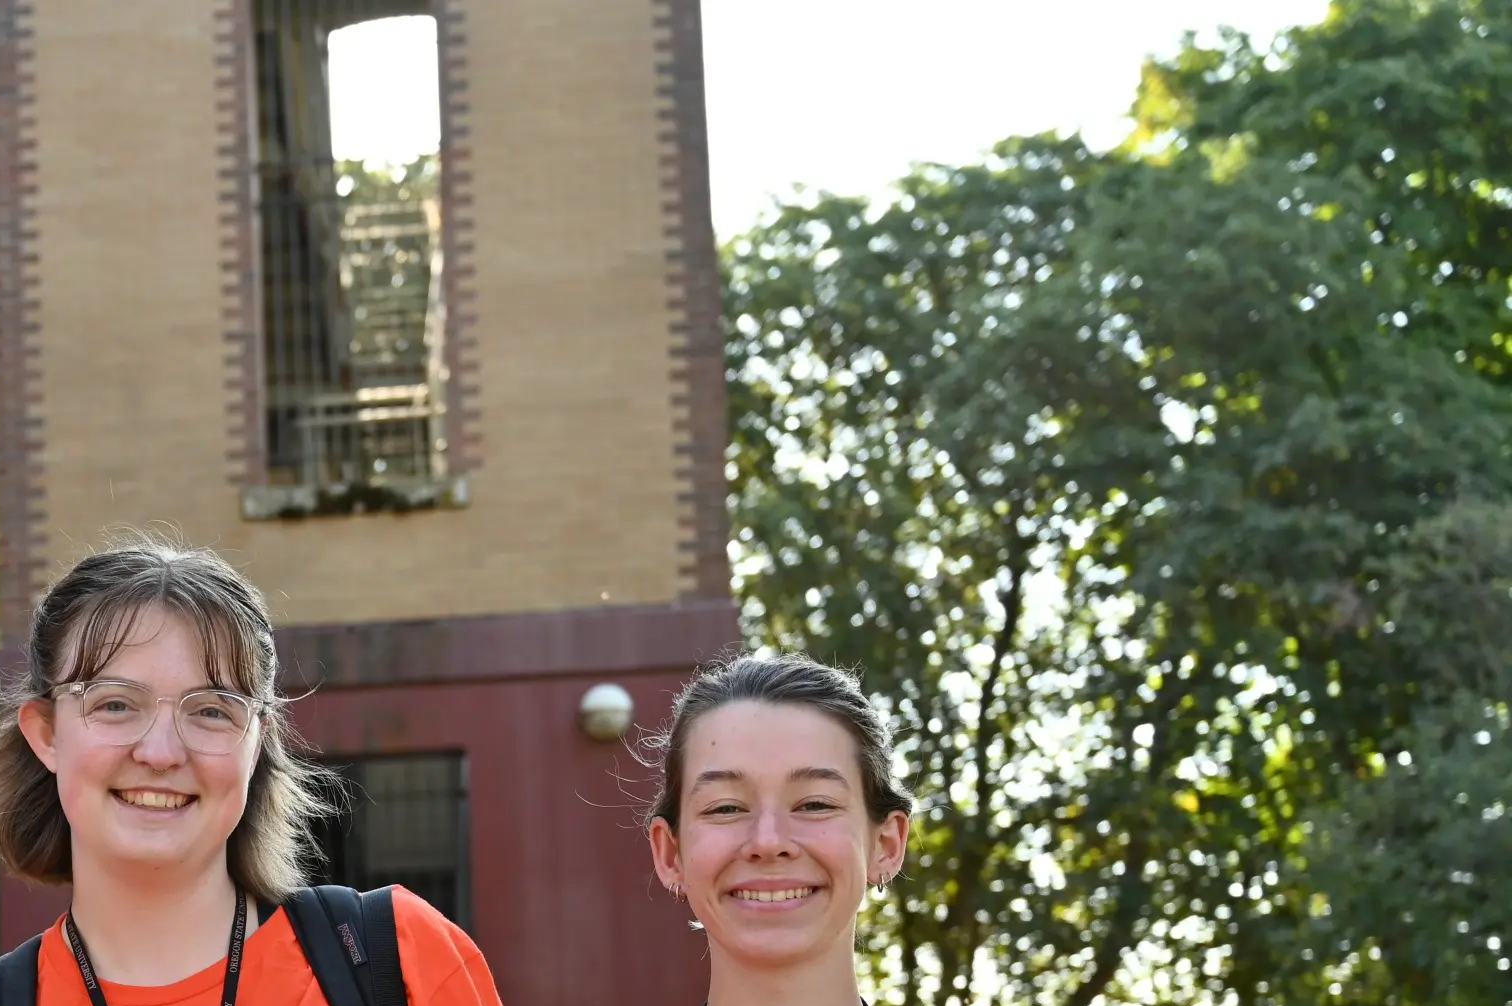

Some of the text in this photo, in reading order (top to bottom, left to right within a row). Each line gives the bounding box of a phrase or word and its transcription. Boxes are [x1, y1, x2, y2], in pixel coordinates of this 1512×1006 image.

[235, 912, 245, 939] STATE
[74, 946, 97, 991] UNIVERSITY
[229, 940, 242, 973] OREGON
